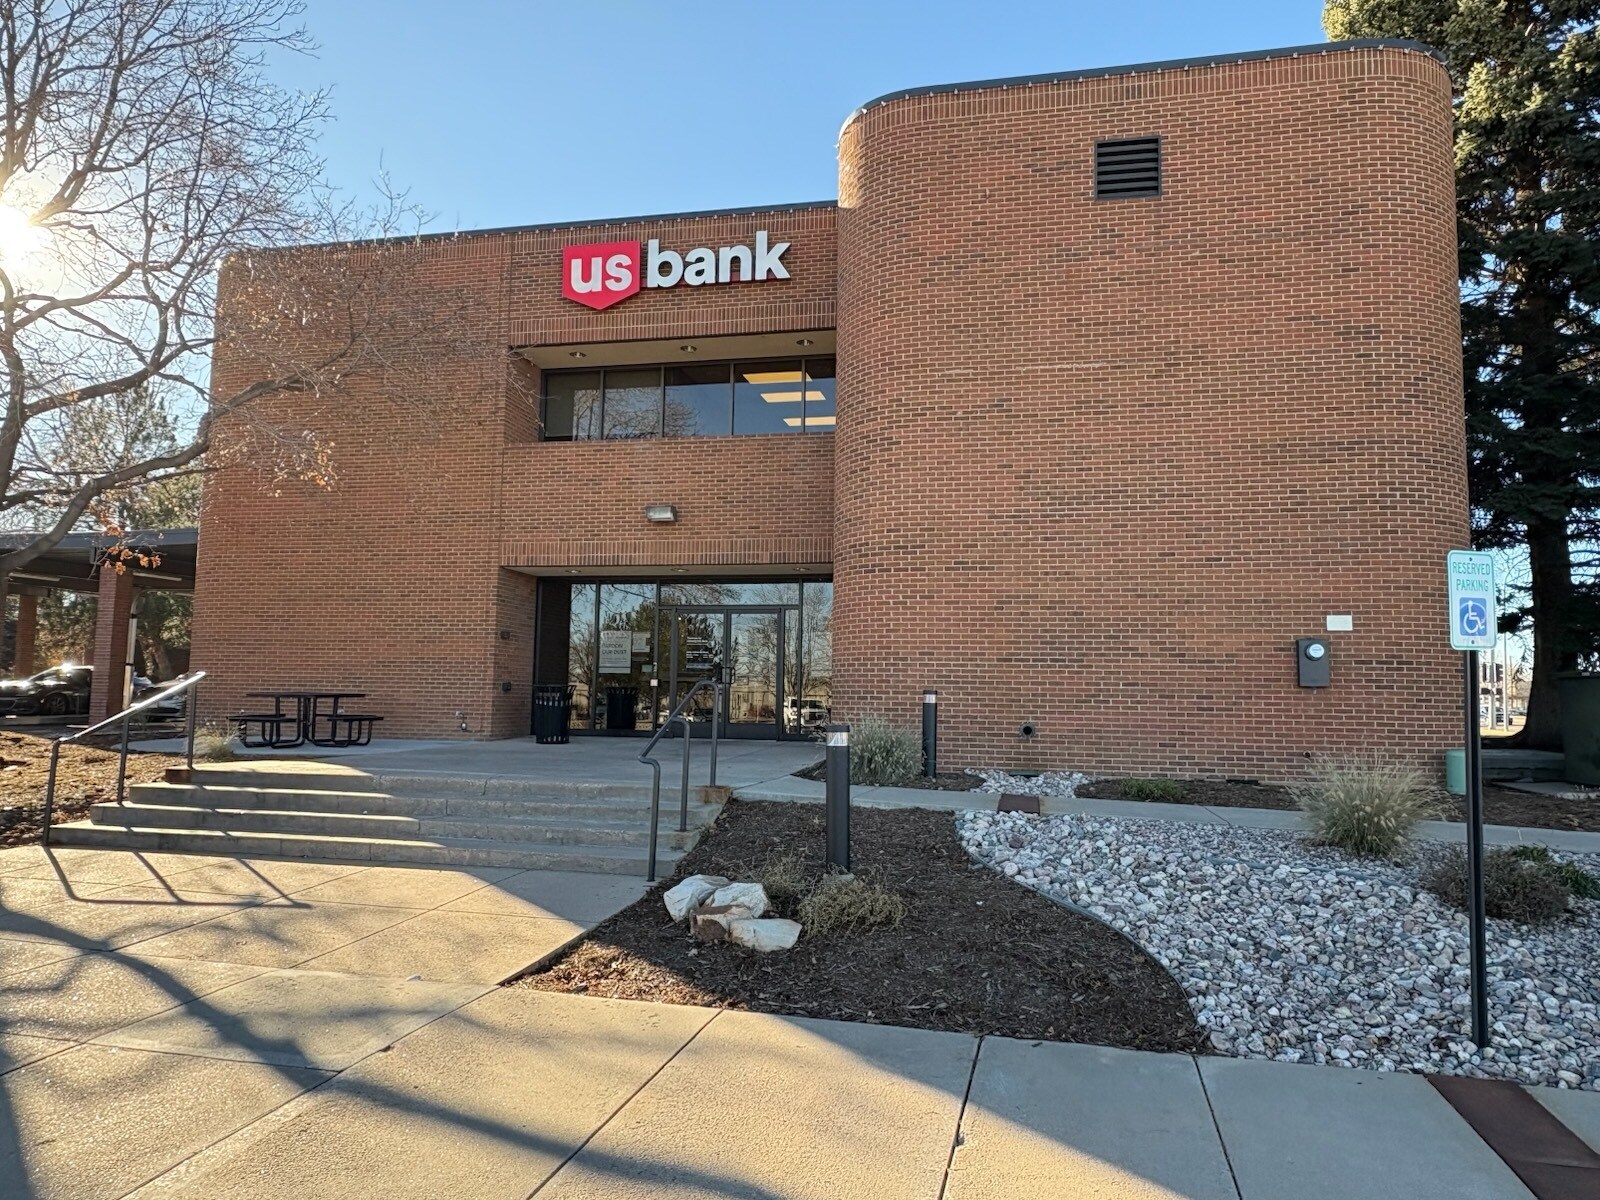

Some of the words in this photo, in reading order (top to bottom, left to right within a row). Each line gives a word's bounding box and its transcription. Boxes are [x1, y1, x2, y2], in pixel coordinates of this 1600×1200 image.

[571, 254, 632, 294] us
[647, 231, 791, 288] bank
[1452, 561, 1491, 576] RESERVED
[1456, 579, 1489, 592] PARKING
